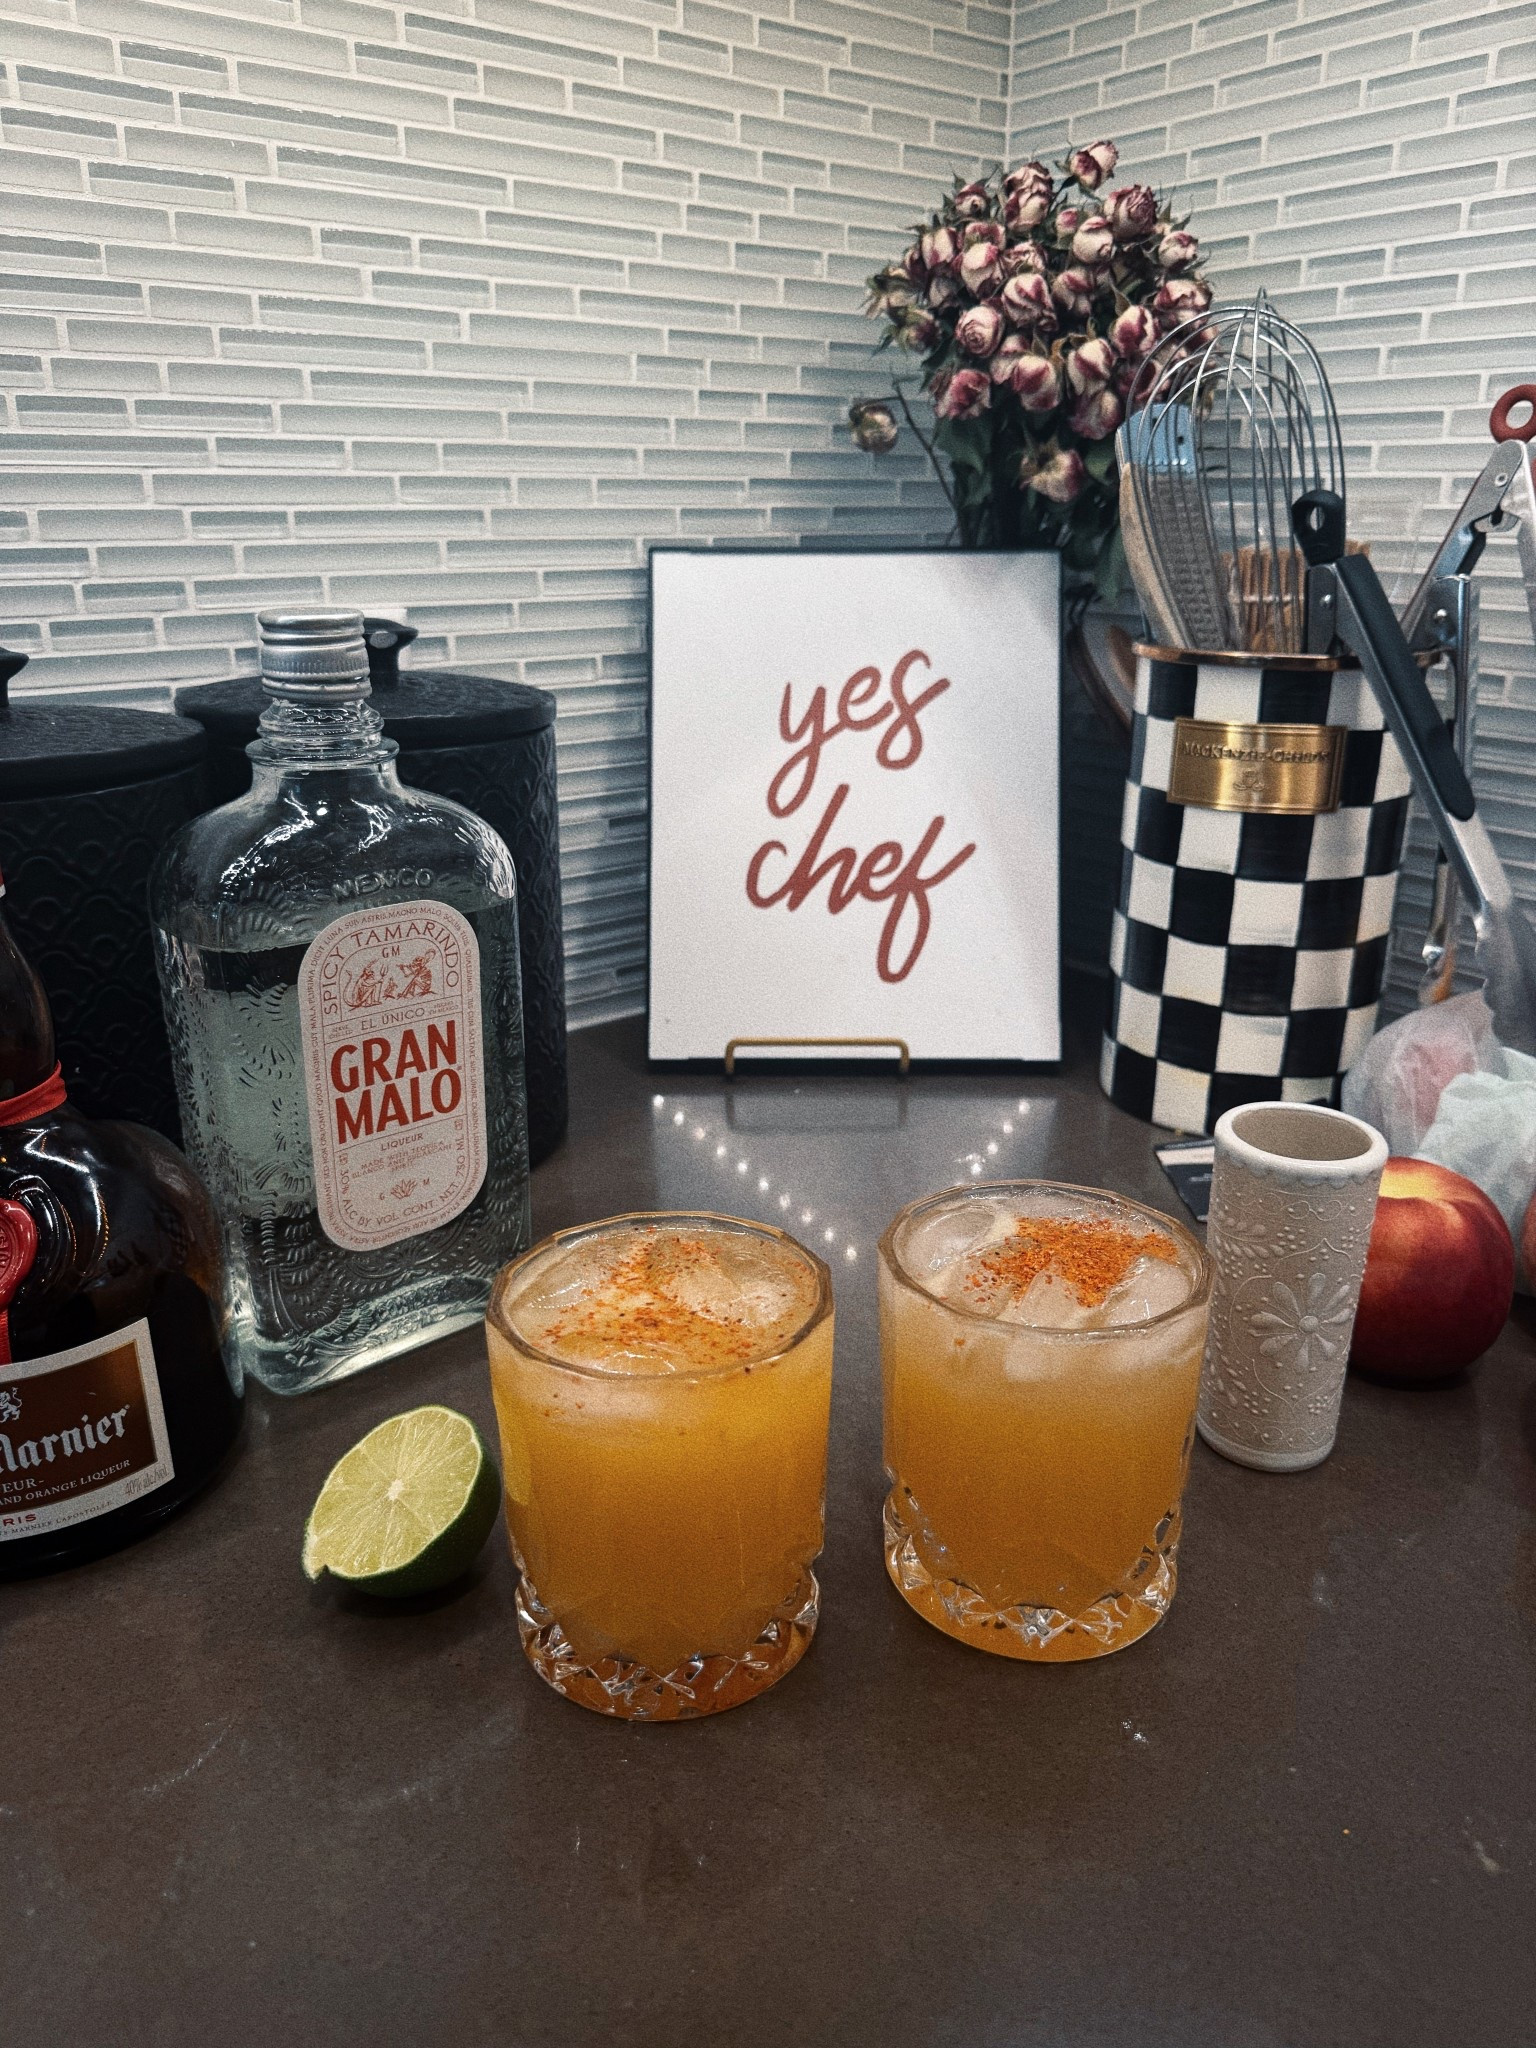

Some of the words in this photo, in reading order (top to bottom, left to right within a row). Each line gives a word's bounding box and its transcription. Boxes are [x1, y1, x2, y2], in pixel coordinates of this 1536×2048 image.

[767, 649, 951, 818] yes
[746, 783, 977, 984] chef
[324, 928, 344, 945] LUNA
[420, 907, 442, 916] MALO
[322, 946, 345, 1015] SPICY
[351, 921, 459, 988] TAMARINDO
[361, 1019, 377, 1031] EL
[382, 1007, 425, 1025] ÚNICO
[330, 1019, 459, 1094] GRAN
[335, 1067, 462, 1145] MALO
[380, 1133, 424, 1151] LIQUEUR
[357, 1216, 372, 1227] BY
[25, 1481, 78, 1500] ORANGE
[80, 1459, 131, 1485] LIQUEUR
[12, 1521, 53, 1534] MARNIER
